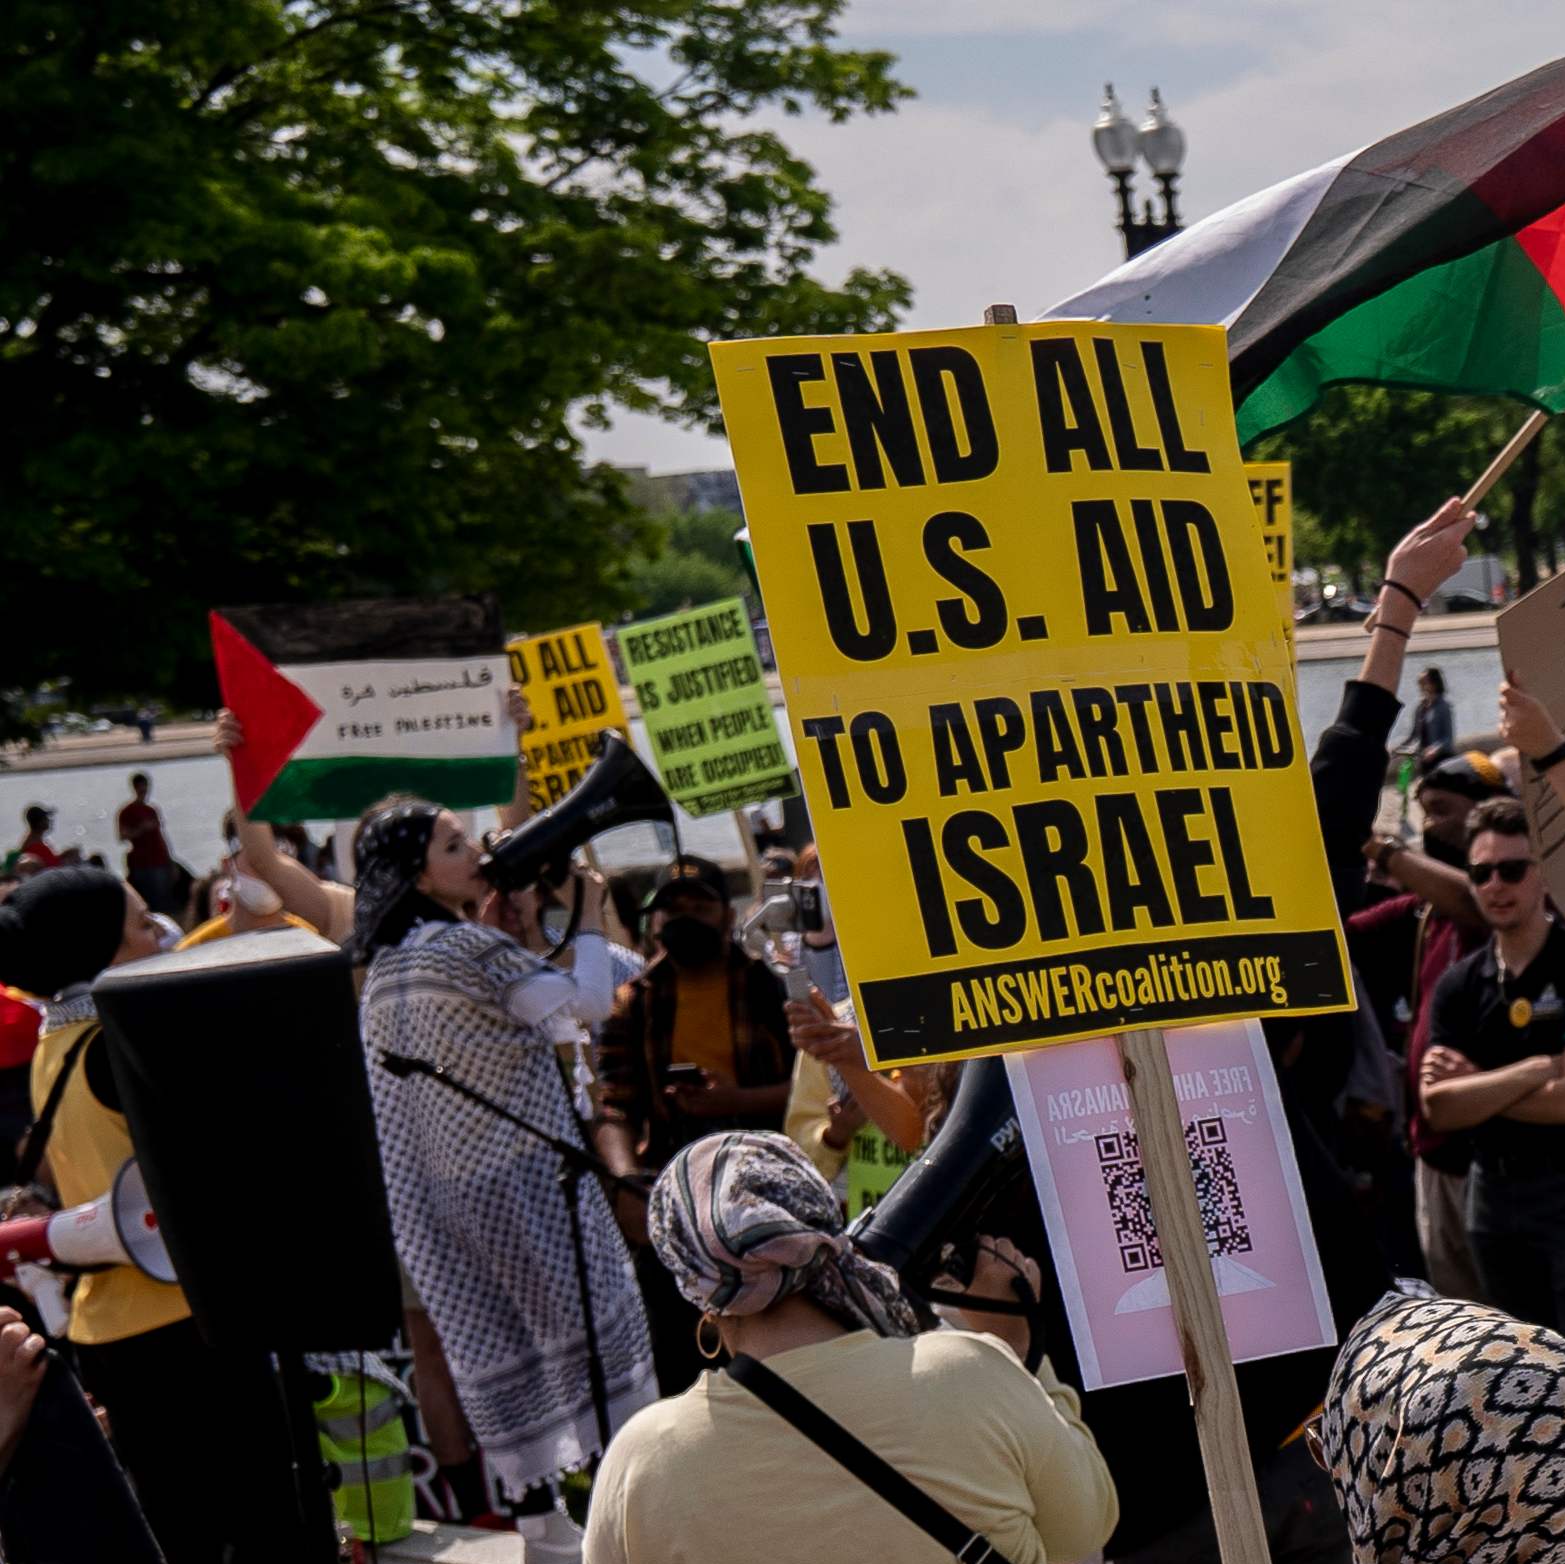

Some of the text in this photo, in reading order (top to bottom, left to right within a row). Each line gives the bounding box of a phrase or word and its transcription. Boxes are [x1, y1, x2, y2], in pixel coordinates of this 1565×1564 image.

[765, 337, 1211, 495] END ALL
[1248, 479, 1283, 526] FF
[806, 498, 1235, 662] U.S. AID
[537, 633, 598, 682] ALL
[626, 608, 746, 666] RESISTANCE
[553, 678, 609, 726] AID
[636, 654, 761, 712] IS JUSTIFIED
[337, 713, 492, 741] FREE PALESTINE
[657, 704, 770, 754] WHEN PEOPLE
[802, 680, 1295, 810] TO APARTHEID
[664, 763, 699, 791] ARE
[900, 786, 1274, 959] ISRAEL
[951, 953, 1288, 1033] ANSWERcoalition.org
